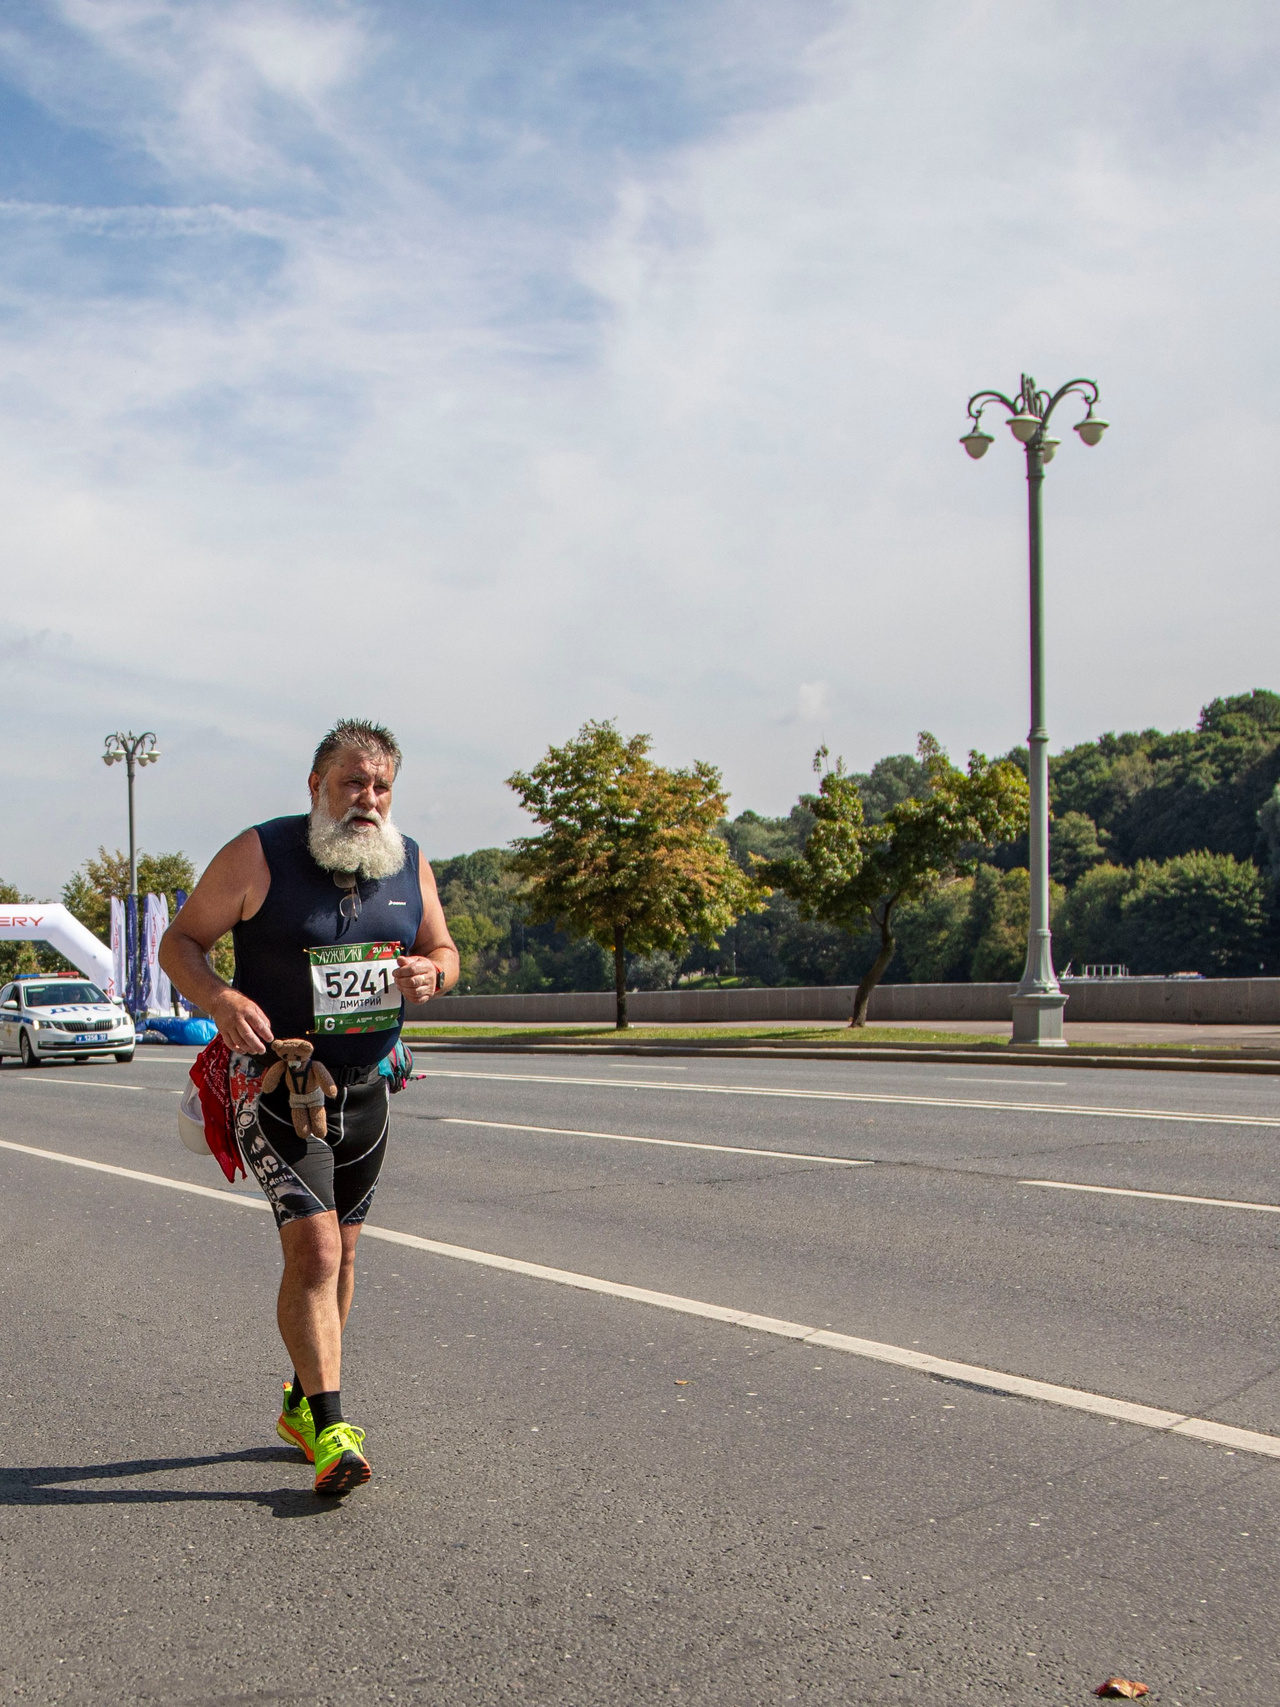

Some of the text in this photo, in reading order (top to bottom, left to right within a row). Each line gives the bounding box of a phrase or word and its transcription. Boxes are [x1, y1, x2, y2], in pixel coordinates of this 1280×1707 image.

[319, 948, 362, 964] ЛУЖНИКИ
[325, 967, 389, 998] 5241
[50, 1005, 111, 1014] ДПС
[339, 995, 382, 1010] ДМИТРИЙ
[324, 1016, 336, 1031] G
